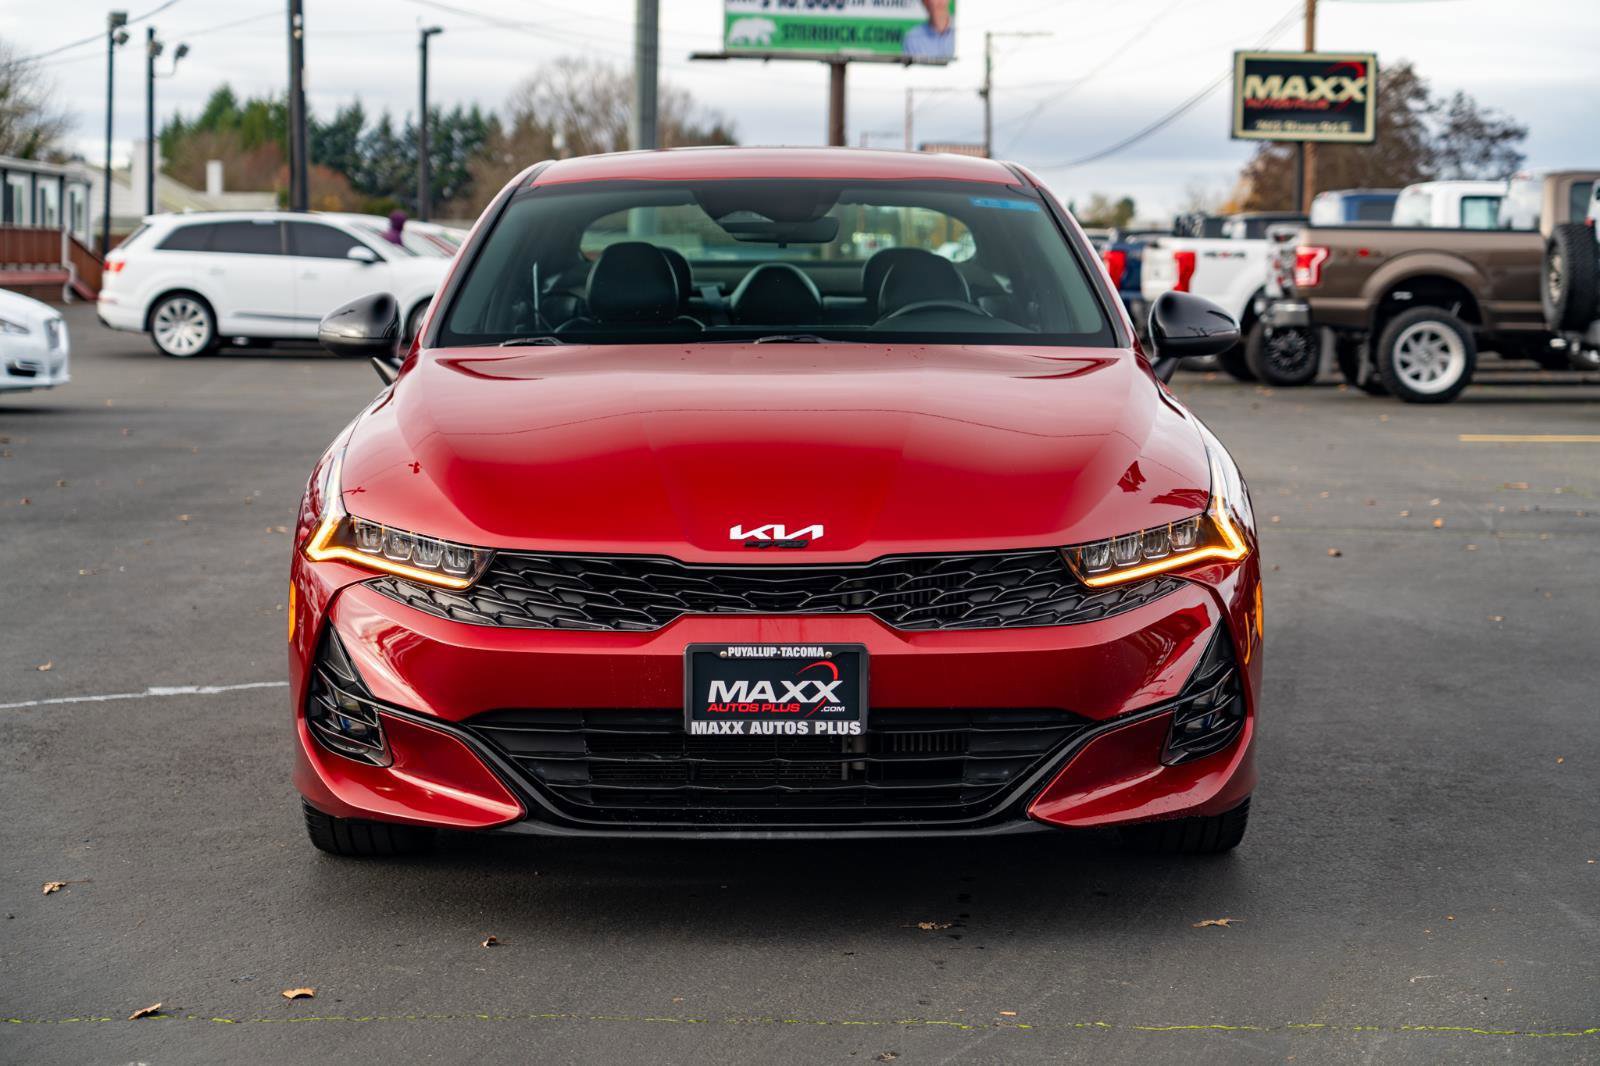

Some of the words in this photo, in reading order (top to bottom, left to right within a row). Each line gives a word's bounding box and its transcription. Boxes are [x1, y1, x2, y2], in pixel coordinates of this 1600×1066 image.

[1245, 75, 1367, 102] MAXX
[707, 680, 843, 703] MAXX
[707, 703, 757, 713] AUTOS
[761, 703, 801, 713] PLUS
[691, 721, 744, 735] MAXX
[750, 721, 809, 735] AUTOS
[815, 721, 861, 735] PLUS
